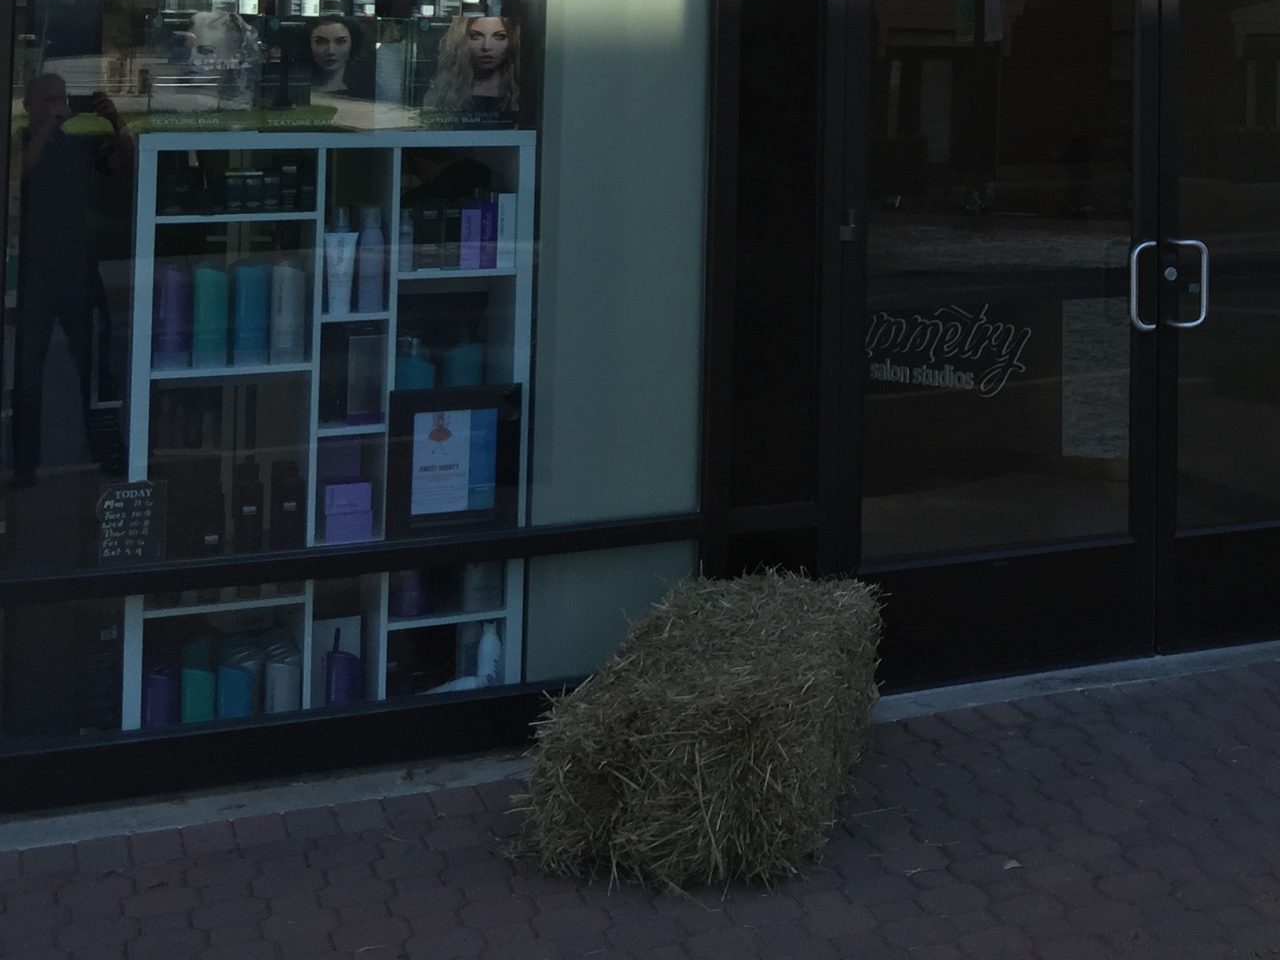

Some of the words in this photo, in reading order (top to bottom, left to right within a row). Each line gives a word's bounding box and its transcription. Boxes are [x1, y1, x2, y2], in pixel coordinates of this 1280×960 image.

[869, 358, 910, 385] salon
[912, 365, 975, 390] studios
[115, 488, 153, 499] TODAY
